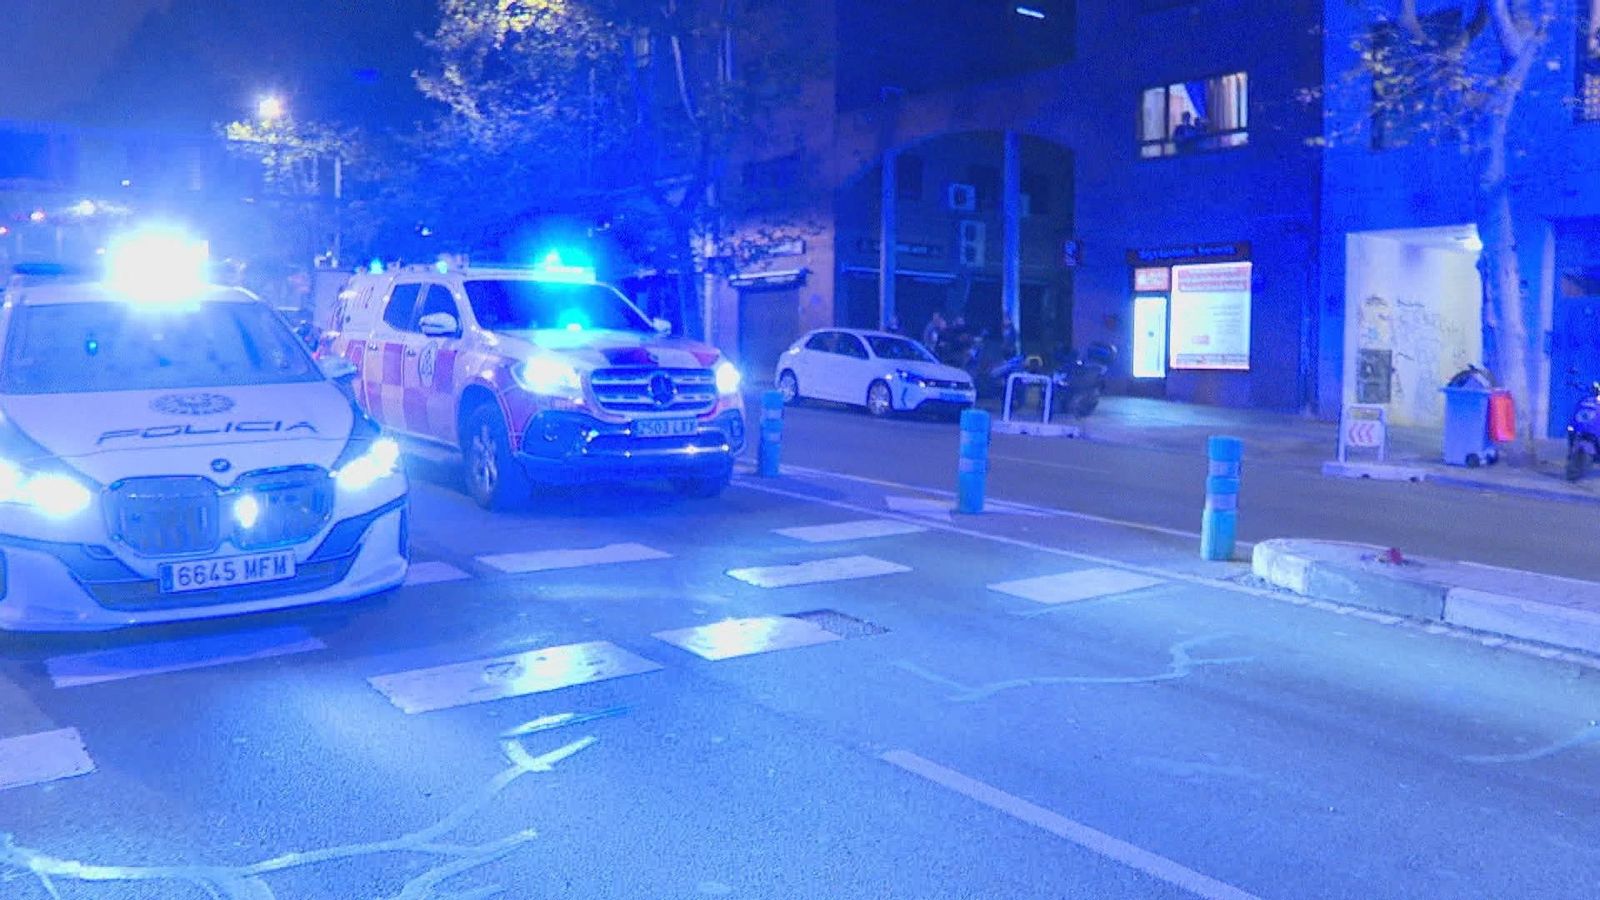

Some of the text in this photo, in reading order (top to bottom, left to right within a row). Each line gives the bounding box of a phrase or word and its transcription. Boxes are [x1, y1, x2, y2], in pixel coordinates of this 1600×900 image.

[96, 420, 318, 444] POLICIA
[177, 555, 287, 586] 6645 MFM
